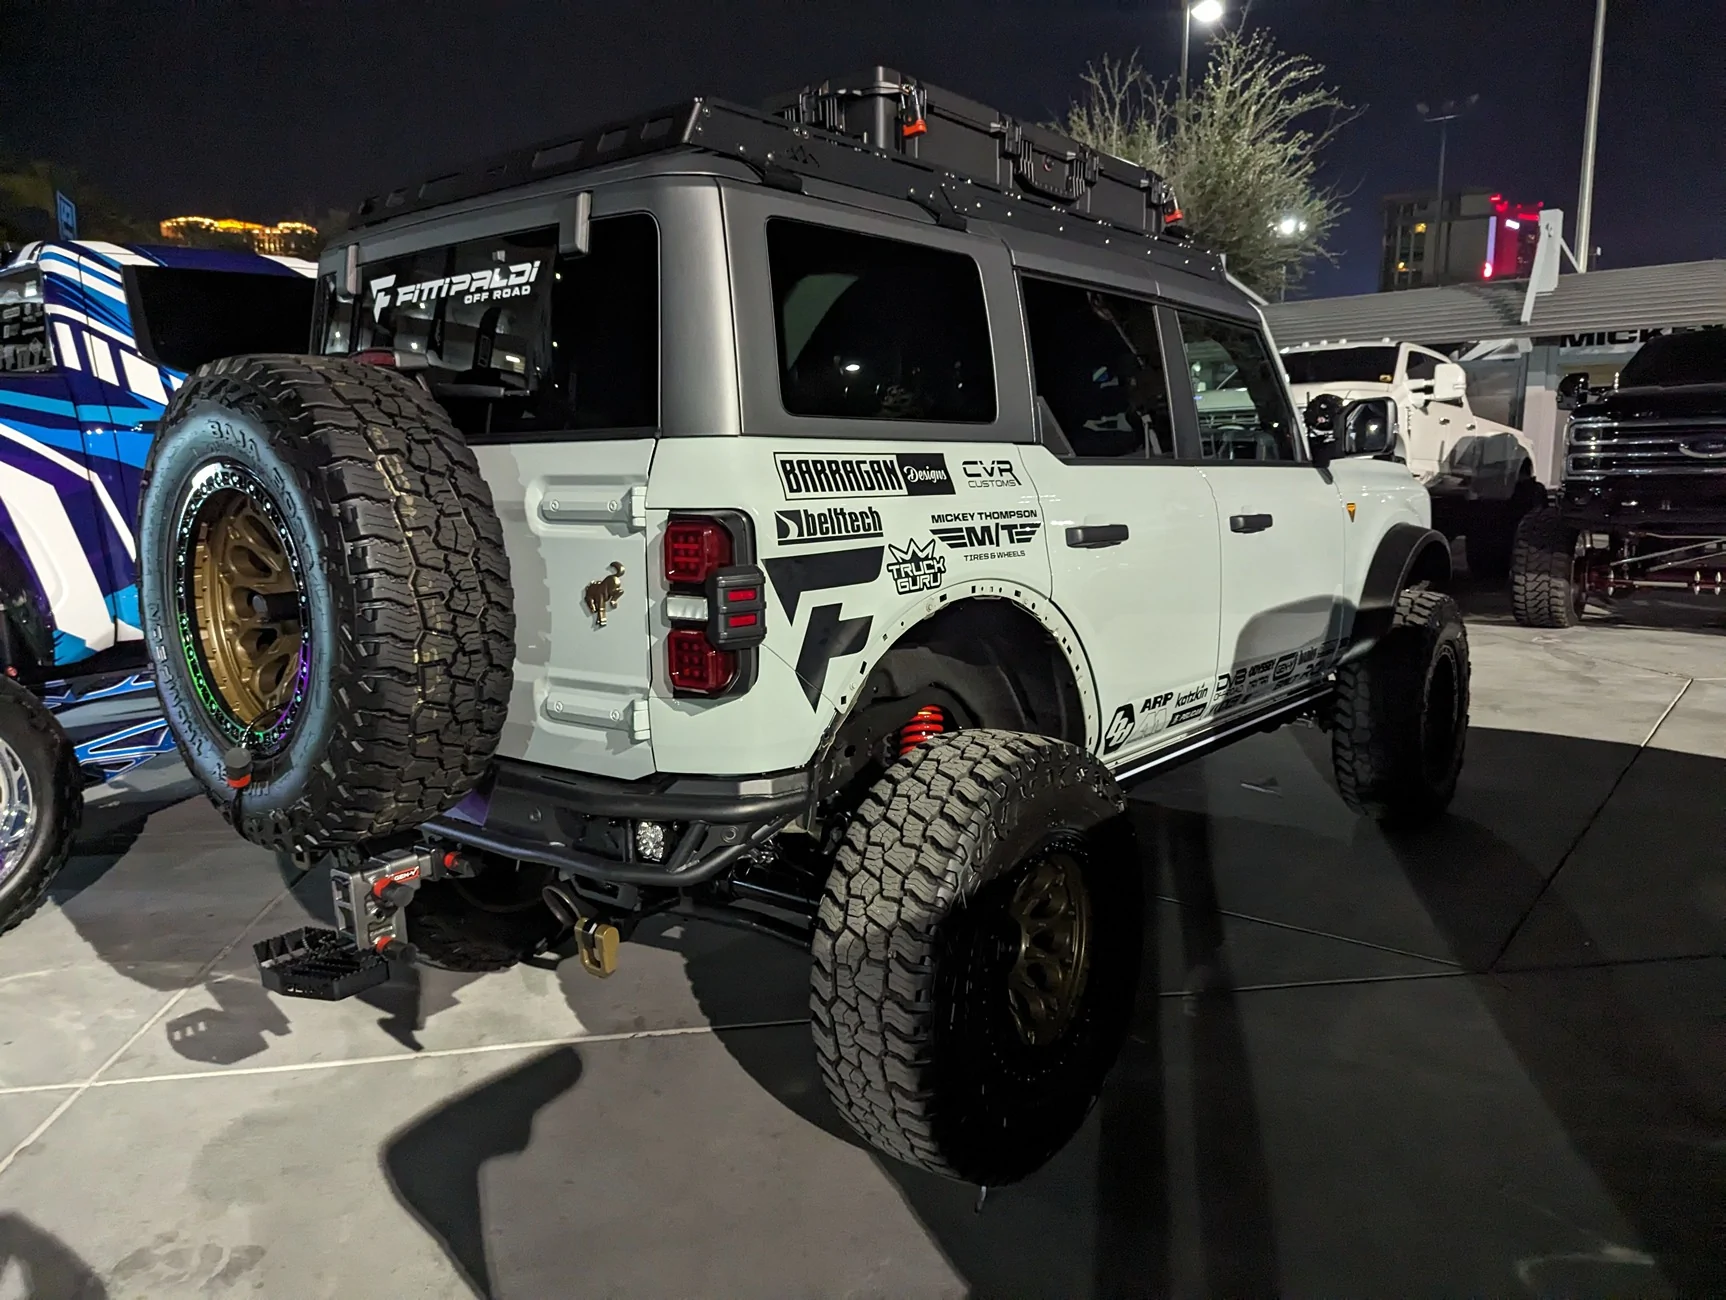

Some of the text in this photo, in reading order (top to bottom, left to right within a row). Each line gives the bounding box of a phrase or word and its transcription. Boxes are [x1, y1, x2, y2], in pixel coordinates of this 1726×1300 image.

[464, 285, 531, 304] OFF ROAD
[780, 460, 947, 493] BARRAGAN Designs
[962, 460, 1022, 486] CVR
[968, 479, 1016, 488] CUSTOMS
[801, 506, 883, 537] belltech
[931, 509, 1038, 524] MICKEY THOMPSON
[963, 553, 989, 562] TIRES
[996, 550, 1025, 559] WHEELS
[888, 556, 946, 580] TRUCK
[895, 572, 942, 592] GURU
[1140, 692, 1173, 713] ARP
